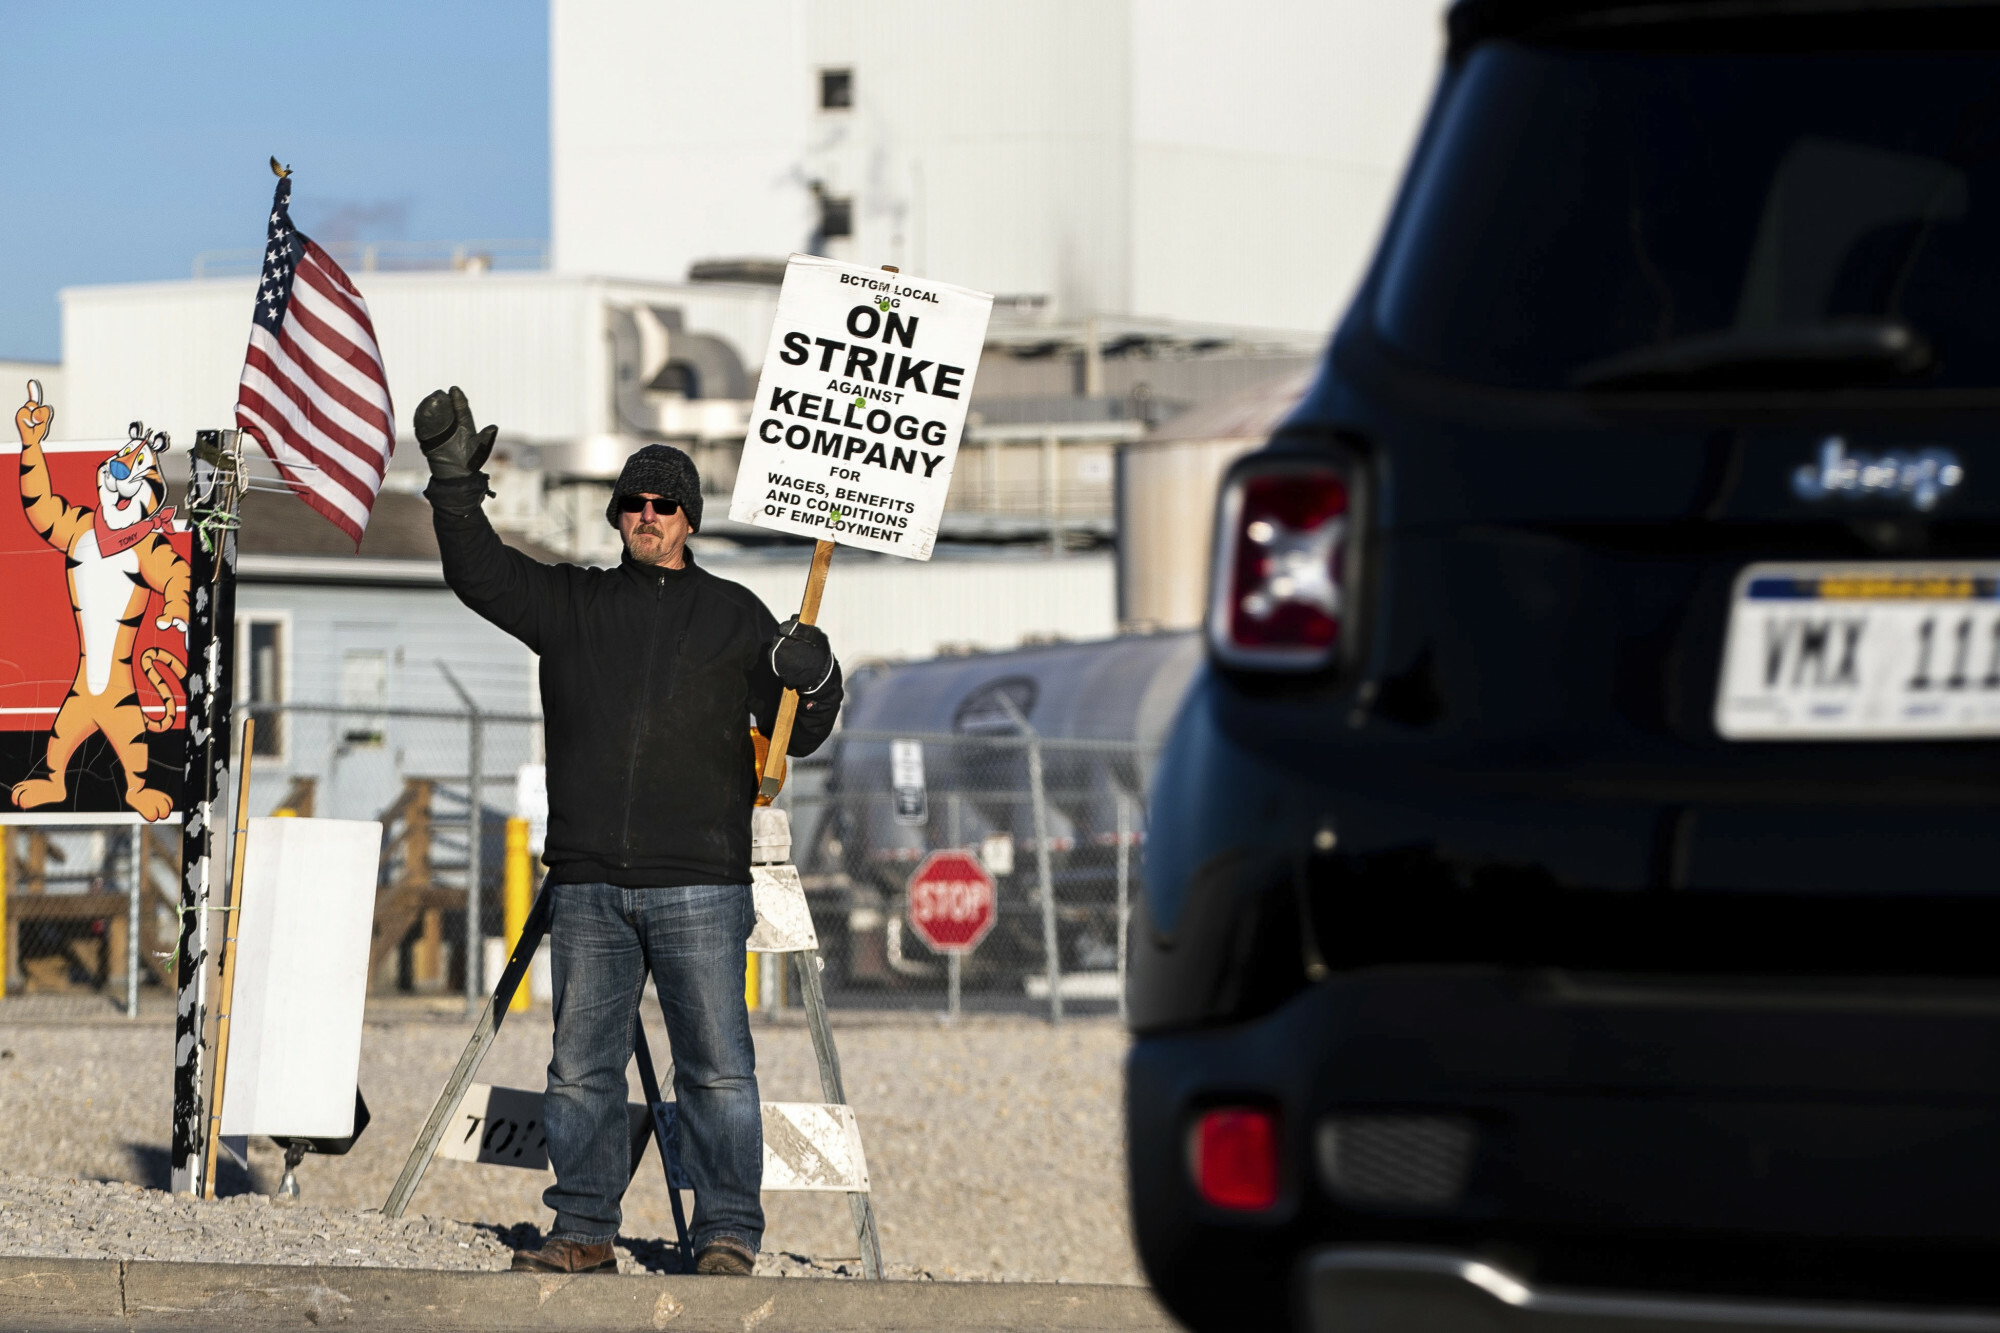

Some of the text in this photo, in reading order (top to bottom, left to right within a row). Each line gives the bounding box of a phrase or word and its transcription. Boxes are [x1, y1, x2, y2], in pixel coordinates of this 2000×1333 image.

[840, 273, 939, 304] BCTGM LOCAL
[846, 304, 919, 349] ON
[779, 331, 965, 400] STRIKE
[826, 379, 905, 405] AGAINST
[769, 386, 947, 446] KELLOGG
[759, 418, 946, 478] COMPANY
[767, 472, 915, 515] WAGES, BENEFITS
[829, 466, 861, 482] FOR
[764, 504, 904, 543] OF EMPLOYMENT
[766, 489, 908, 529] AND CONDITIONS
[118, 532, 138, 547] TONY
[916, 881, 991, 922] STOP
